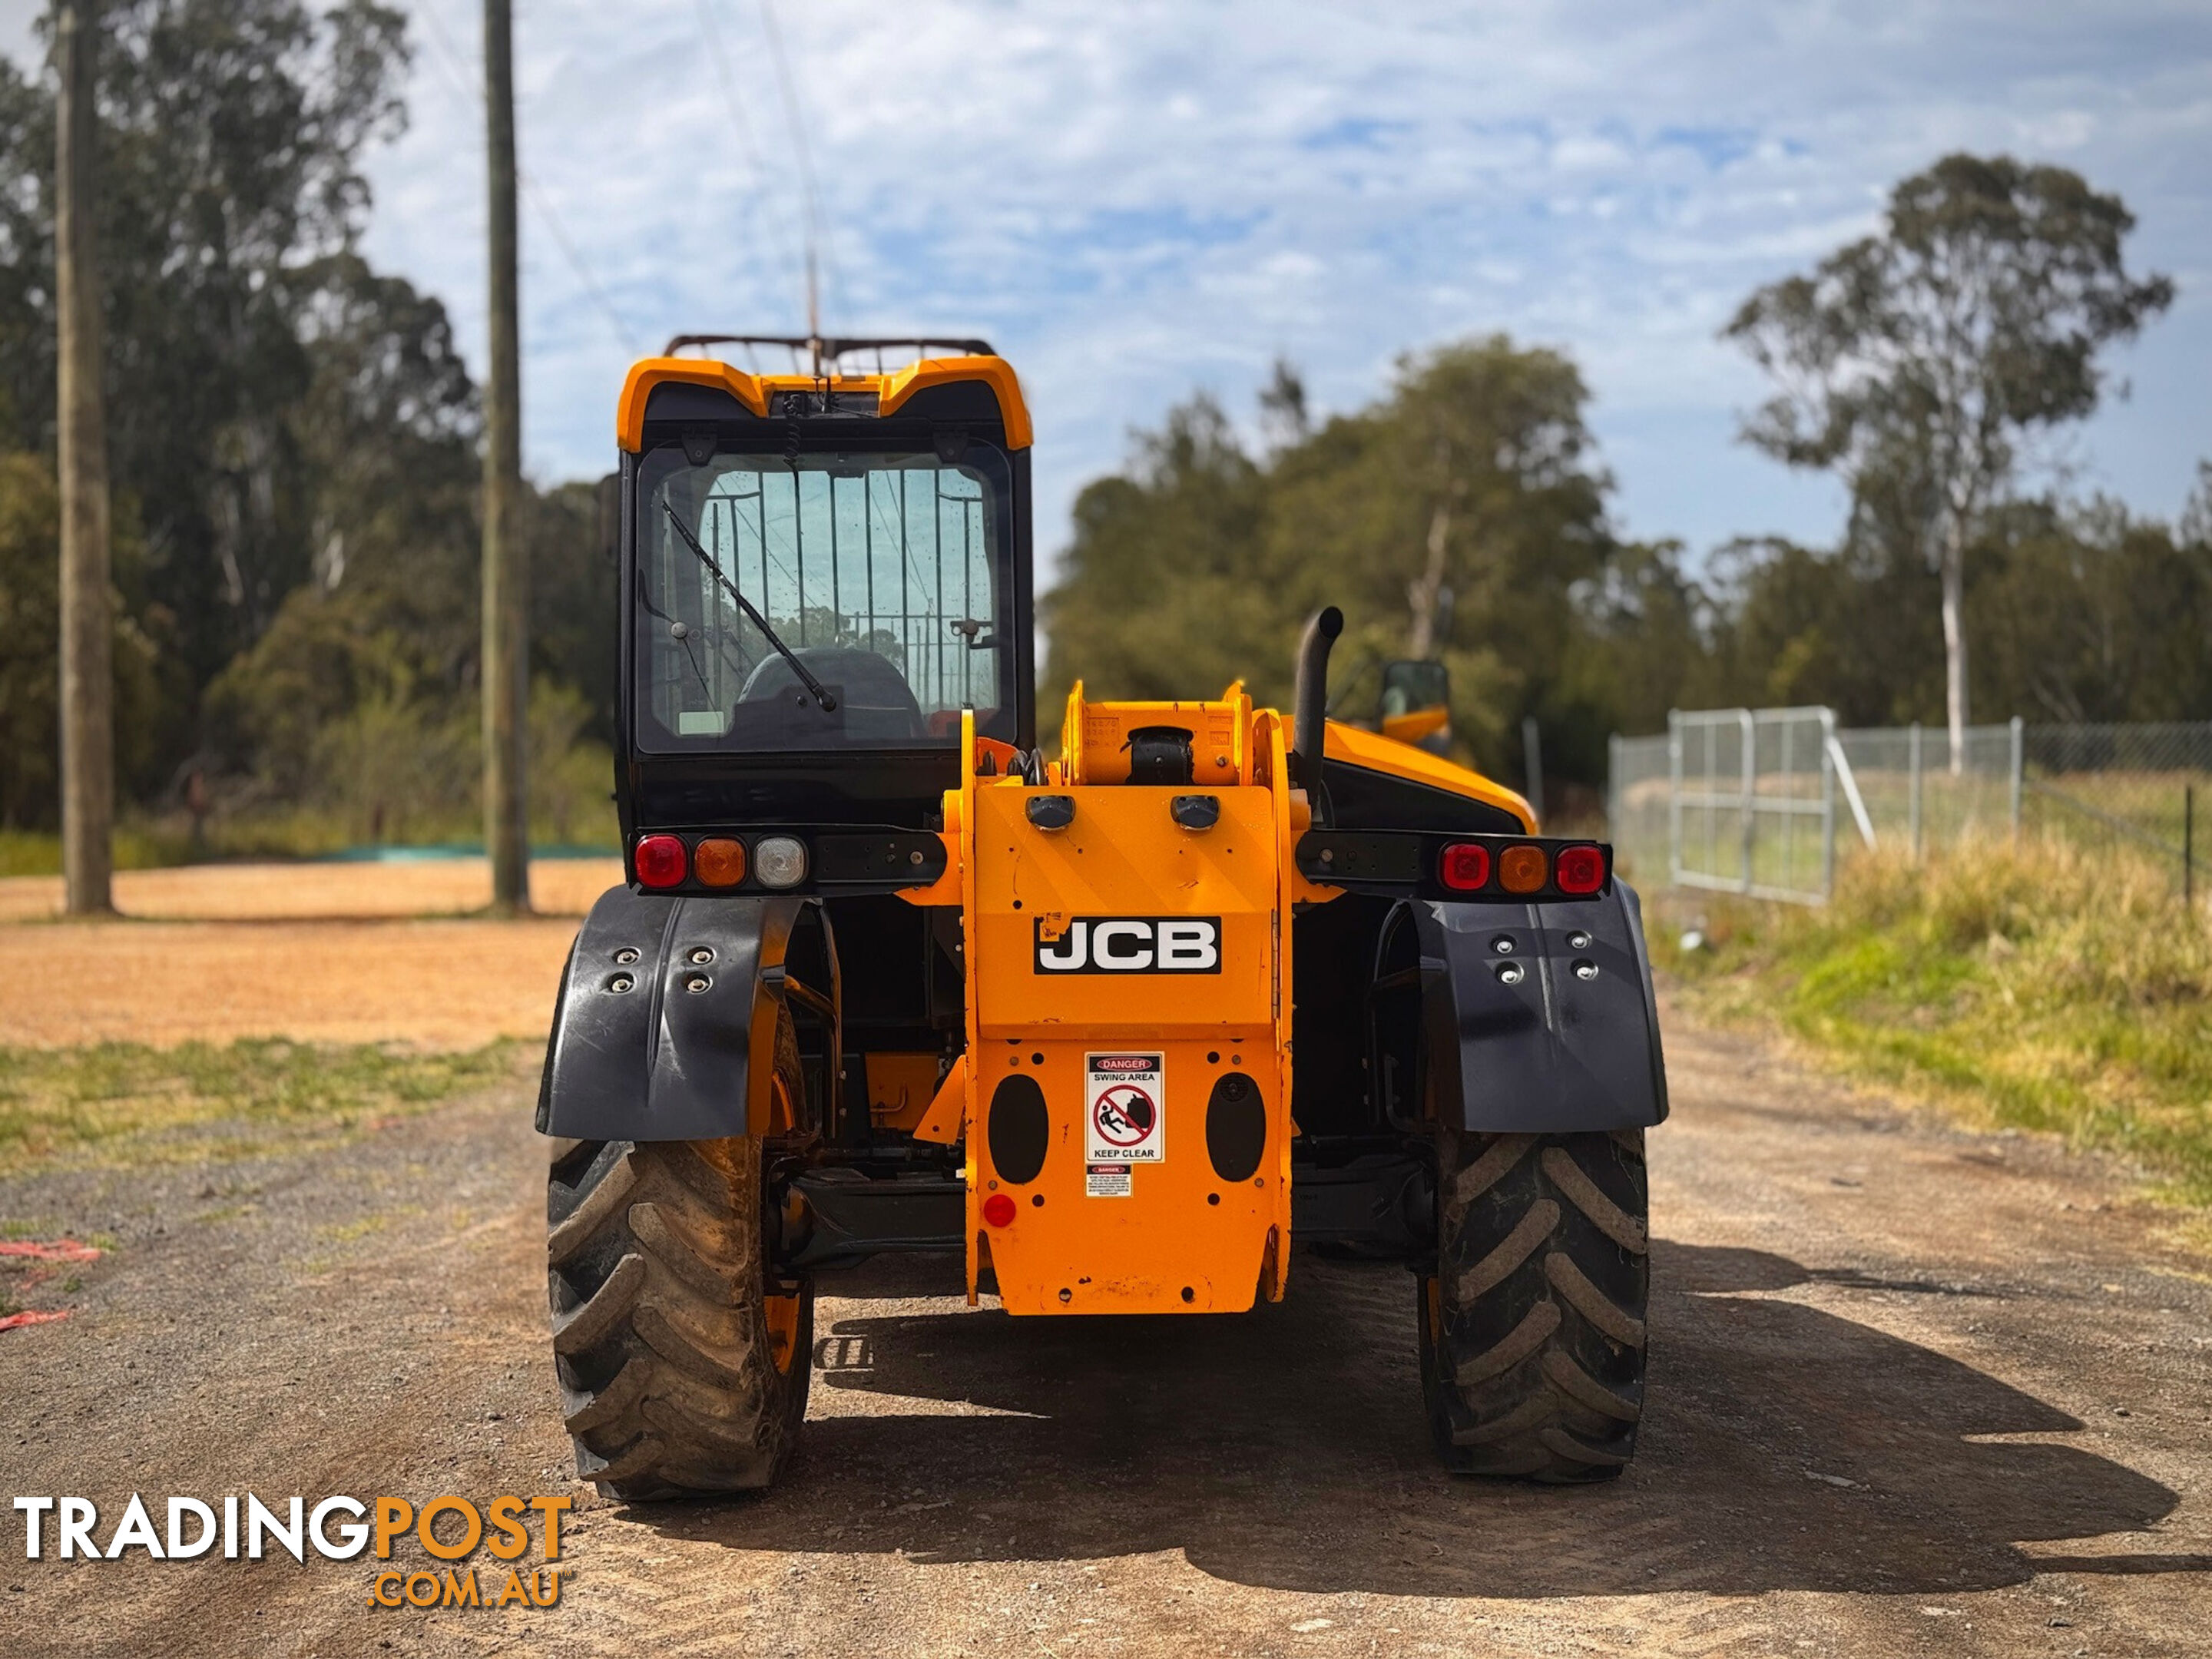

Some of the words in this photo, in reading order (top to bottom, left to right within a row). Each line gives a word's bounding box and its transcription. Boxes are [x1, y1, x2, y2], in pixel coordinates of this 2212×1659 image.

[1039, 921, 1217, 970] JCB
[1103, 1060, 1146, 1069] DANGER
[1094, 1073, 1126, 1081] SWING
[1128, 1073, 1155, 1081] AREA
[1094, 1149, 1120, 1157] KEEP
[1122, 1149, 1154, 1157] CLEAR
